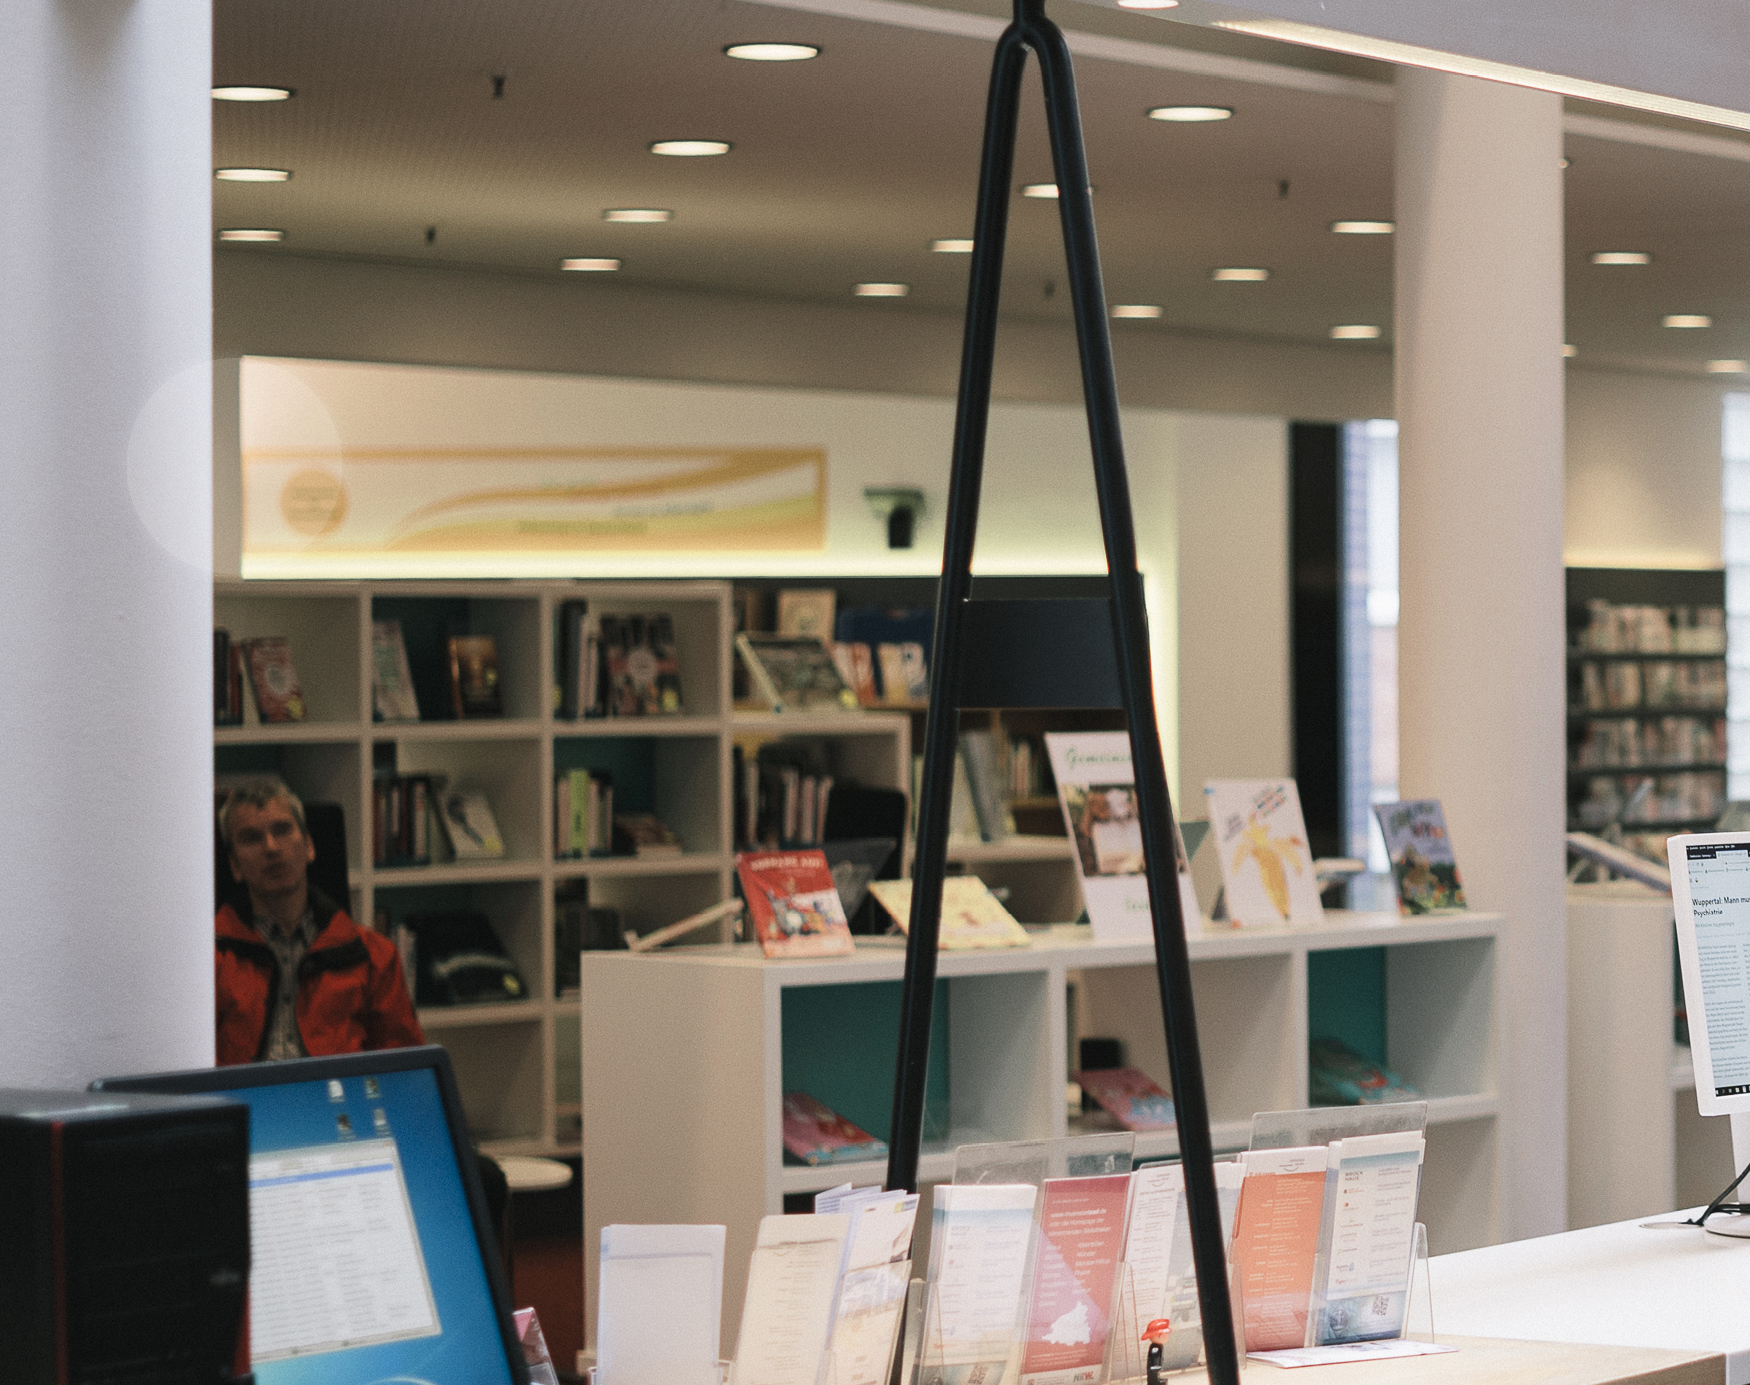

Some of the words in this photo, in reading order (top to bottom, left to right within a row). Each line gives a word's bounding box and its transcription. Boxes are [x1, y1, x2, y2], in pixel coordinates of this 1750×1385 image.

[1692, 897, 1722, 908] Wuppertal:
[1724, 896, 1740, 904] Mann
[1693, 909, 1722, 918] Psychiatrie
